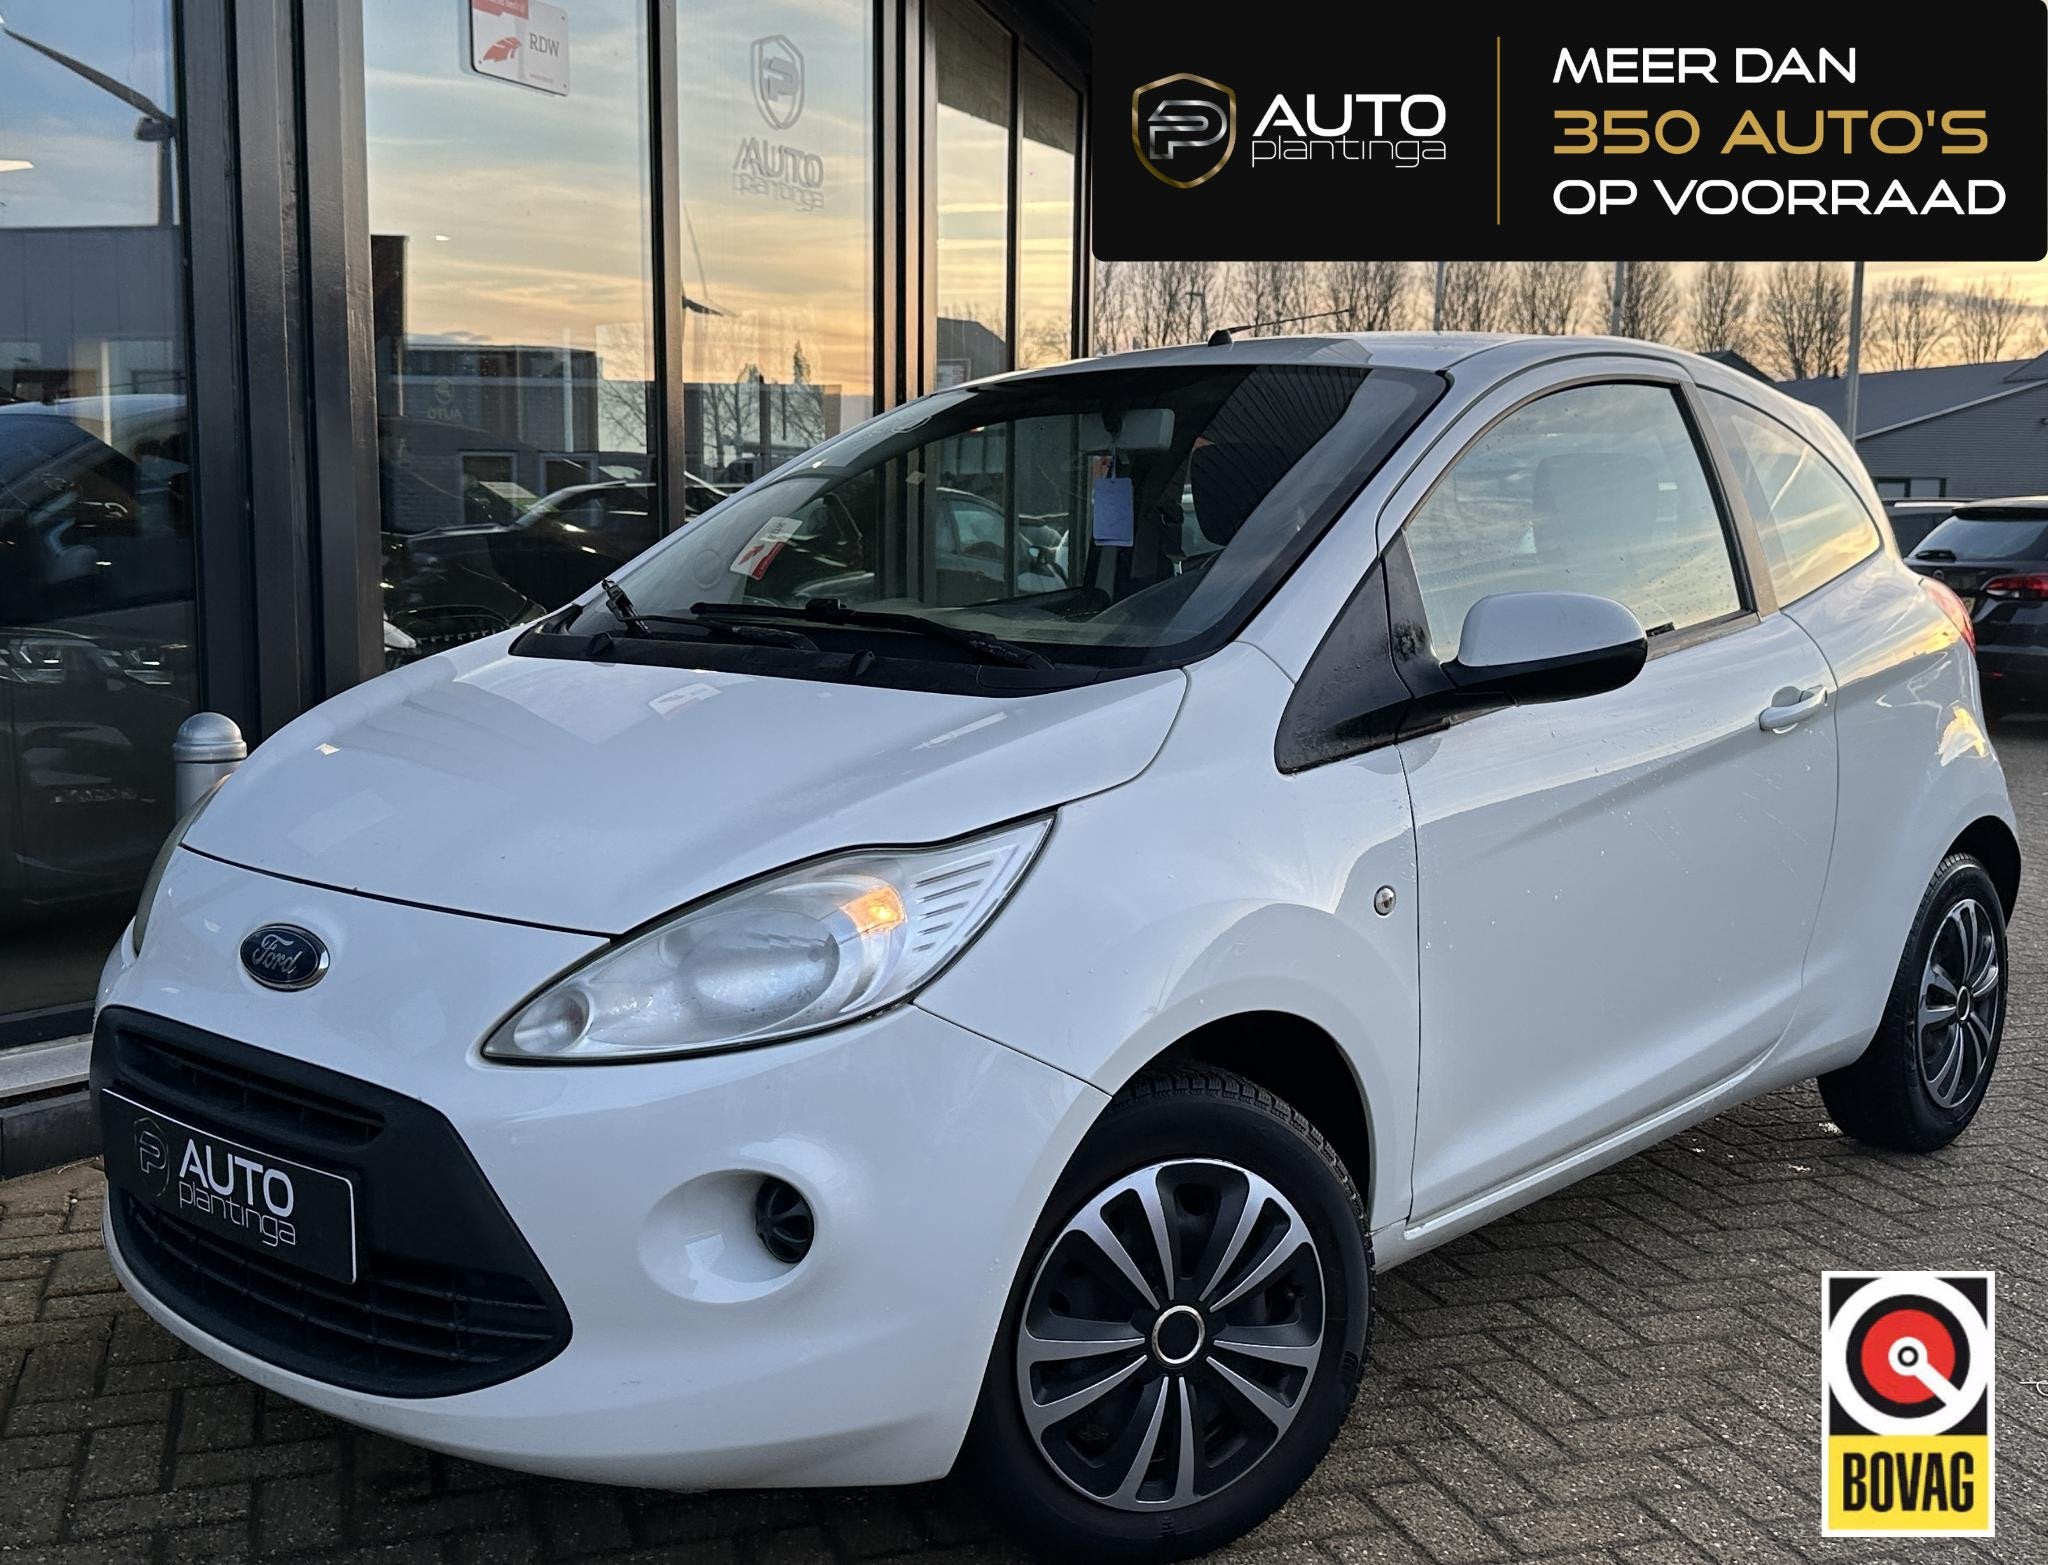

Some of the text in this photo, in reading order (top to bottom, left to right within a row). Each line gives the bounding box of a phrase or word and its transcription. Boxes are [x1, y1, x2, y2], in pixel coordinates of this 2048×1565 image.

[529, 32, 560, 58] RDW
[733, 137, 824, 188] AUTO
[252, 934, 303, 974] Ford
[179, 1138, 295, 1218] AUTO
[178, 1180, 296, 1247] plantinga
